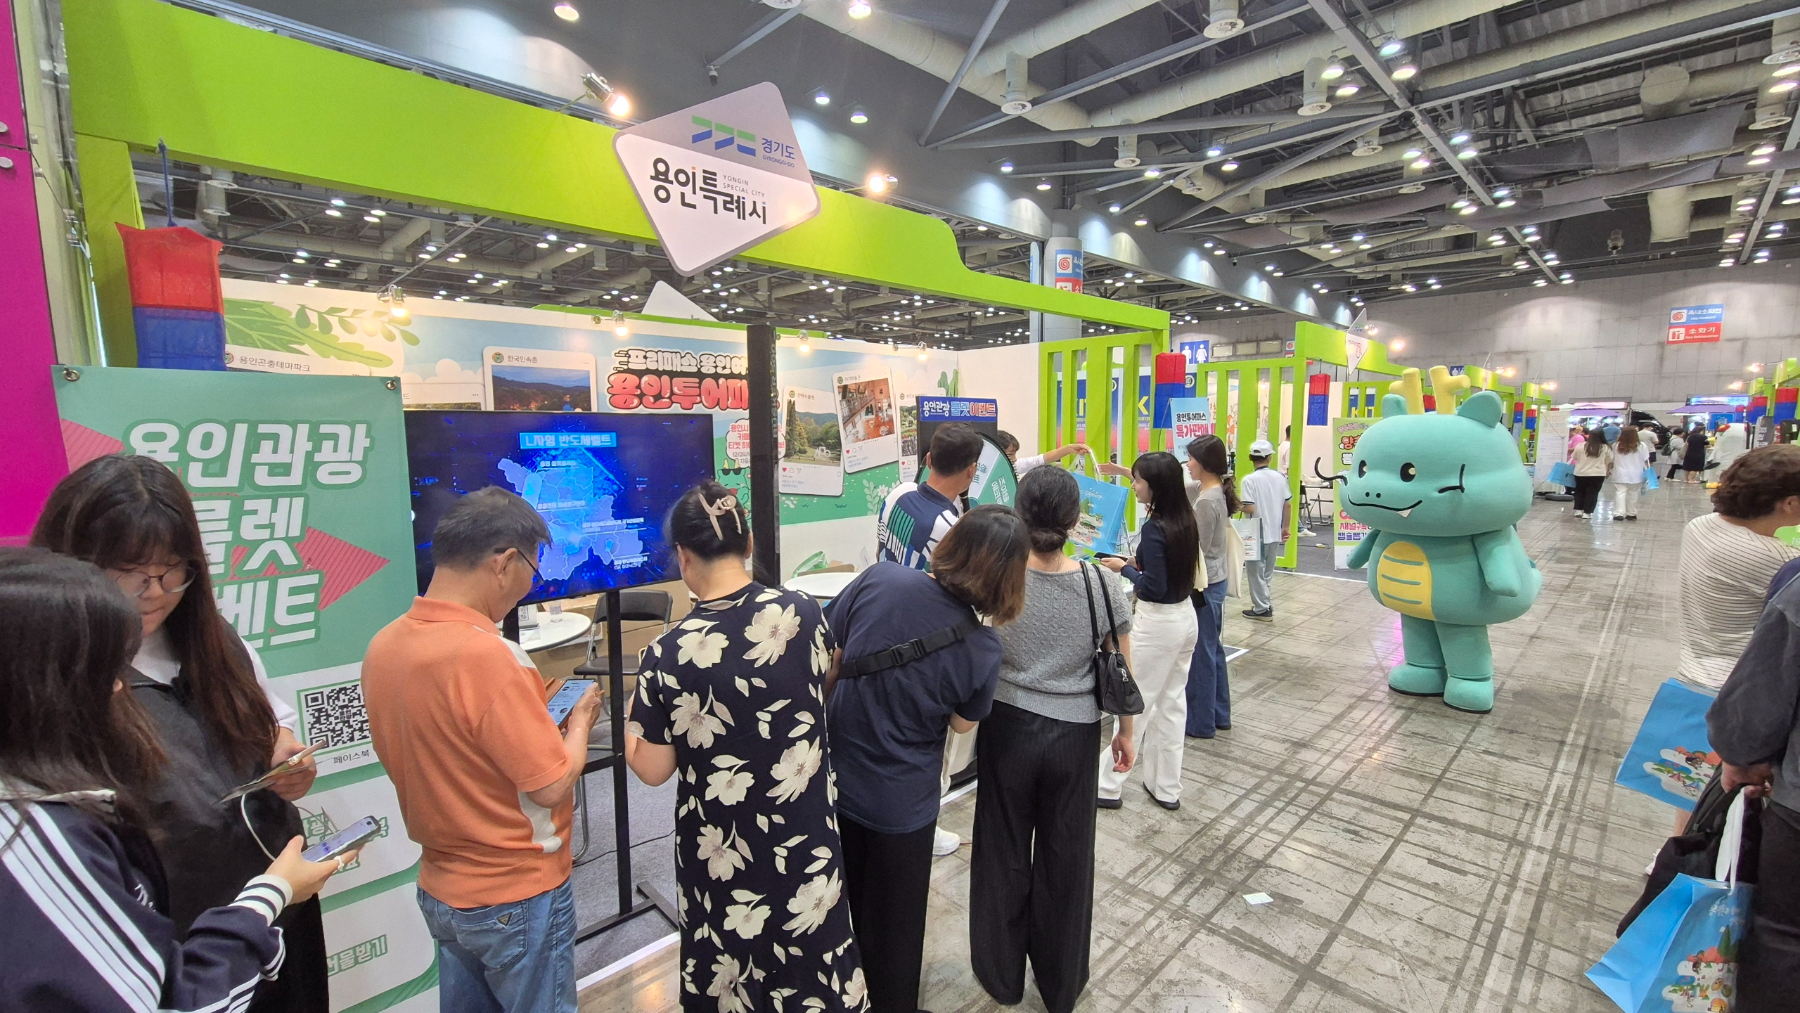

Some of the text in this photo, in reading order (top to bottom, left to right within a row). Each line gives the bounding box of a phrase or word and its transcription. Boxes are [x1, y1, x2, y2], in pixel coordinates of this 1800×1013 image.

[761, 137, 796, 160] 경기도
[762, 154, 795, 168] GYEONGGI-DO
[722, 174, 749, 186] YONGIN
[650, 157, 767, 225] 용인특례시
[722, 182, 766, 198] SPECIAL CITY
[238, 355, 311, 373] 용인곤충테마파크
[507, 354, 538, 364] 한국민속촌
[627, 349, 748, 376] 프리패스 용인여
[923, 400, 950, 417] 용인관광
[969, 402, 996, 417] 이벤트
[128, 422, 371, 488] 용인관광
[333, 749, 370, 765] 페이스북
